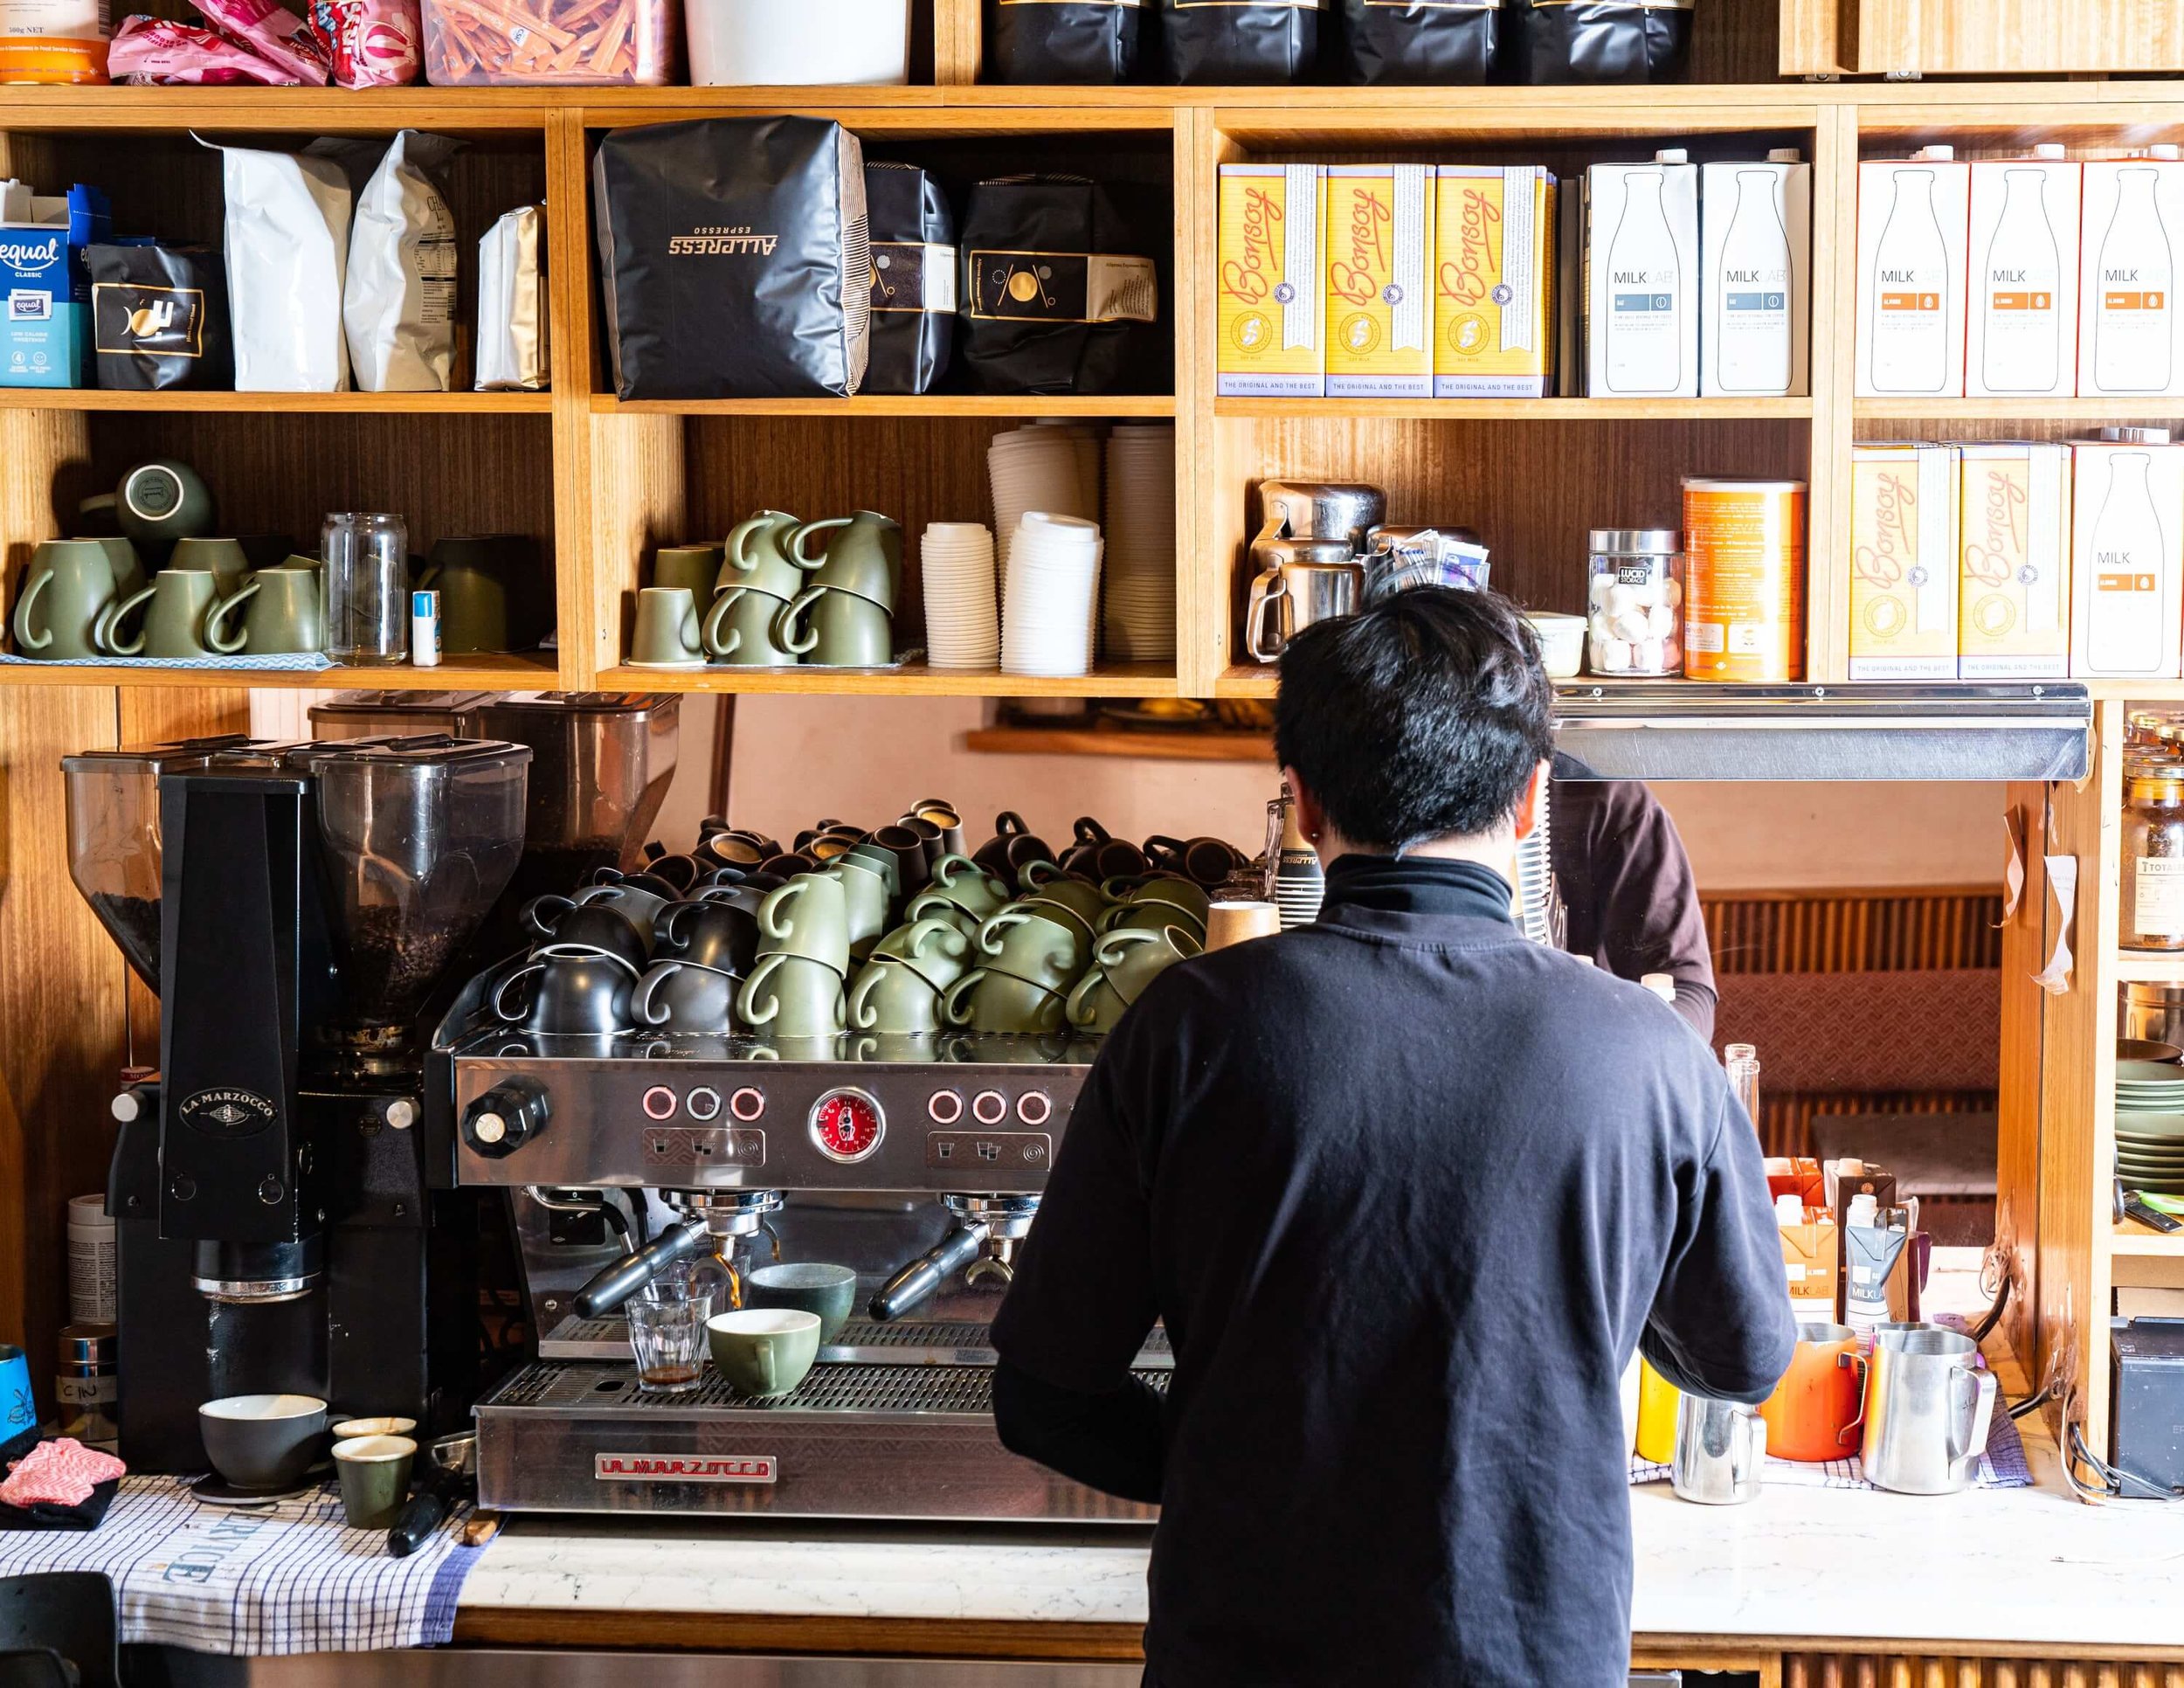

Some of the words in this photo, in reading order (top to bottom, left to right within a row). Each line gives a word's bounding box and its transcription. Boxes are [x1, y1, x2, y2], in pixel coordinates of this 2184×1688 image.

[0, 238, 59, 266] equal
[668, 238, 778, 255] ALLPRESS
[1222, 188, 1282, 305] Bonsoy
[1330, 188, 1390, 306] Bonsoy
[1439, 188, 1500, 306] Bonsoy
[17, 299, 41, 311] equal
[1854, 473, 1915, 589] Bonsoy
[1964, 471, 2026, 587] Bonsoy
[2098, 552, 2131, 564] MILK
[1621, 569, 1645, 578] LUCID
[182, 1101, 199, 1114] LA
[201, 1092, 273, 1117] MARZOCCO
[1852, 1288, 1883, 1299] MILKLA
[602, 1458, 623, 1473] LA
[633, 1458, 770, 1476] MARZOCCO
[162, 1505, 275, 1582] ERVICE
